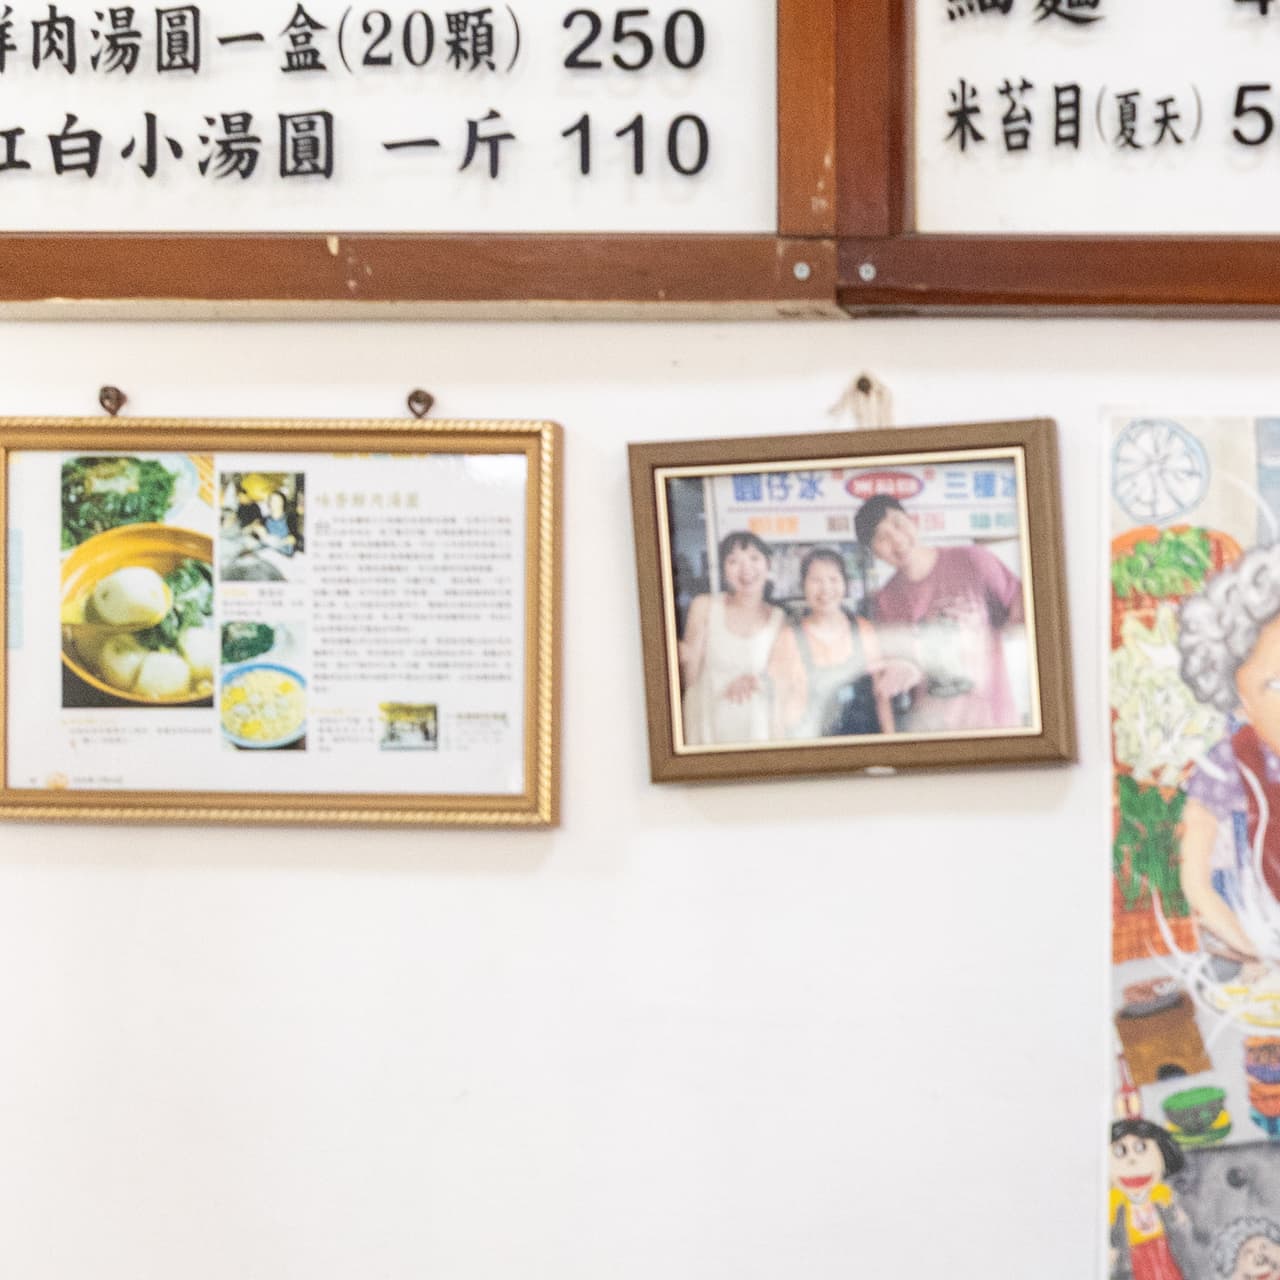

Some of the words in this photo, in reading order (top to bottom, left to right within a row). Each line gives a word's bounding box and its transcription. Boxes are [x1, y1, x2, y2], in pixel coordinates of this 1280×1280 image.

[563, 9, 705, 72] 250
[382, 110, 516, 180] 一斤
[562, 113, 709, 177] 110
[945, 79, 1204, 152] 米苔目(夏天)
